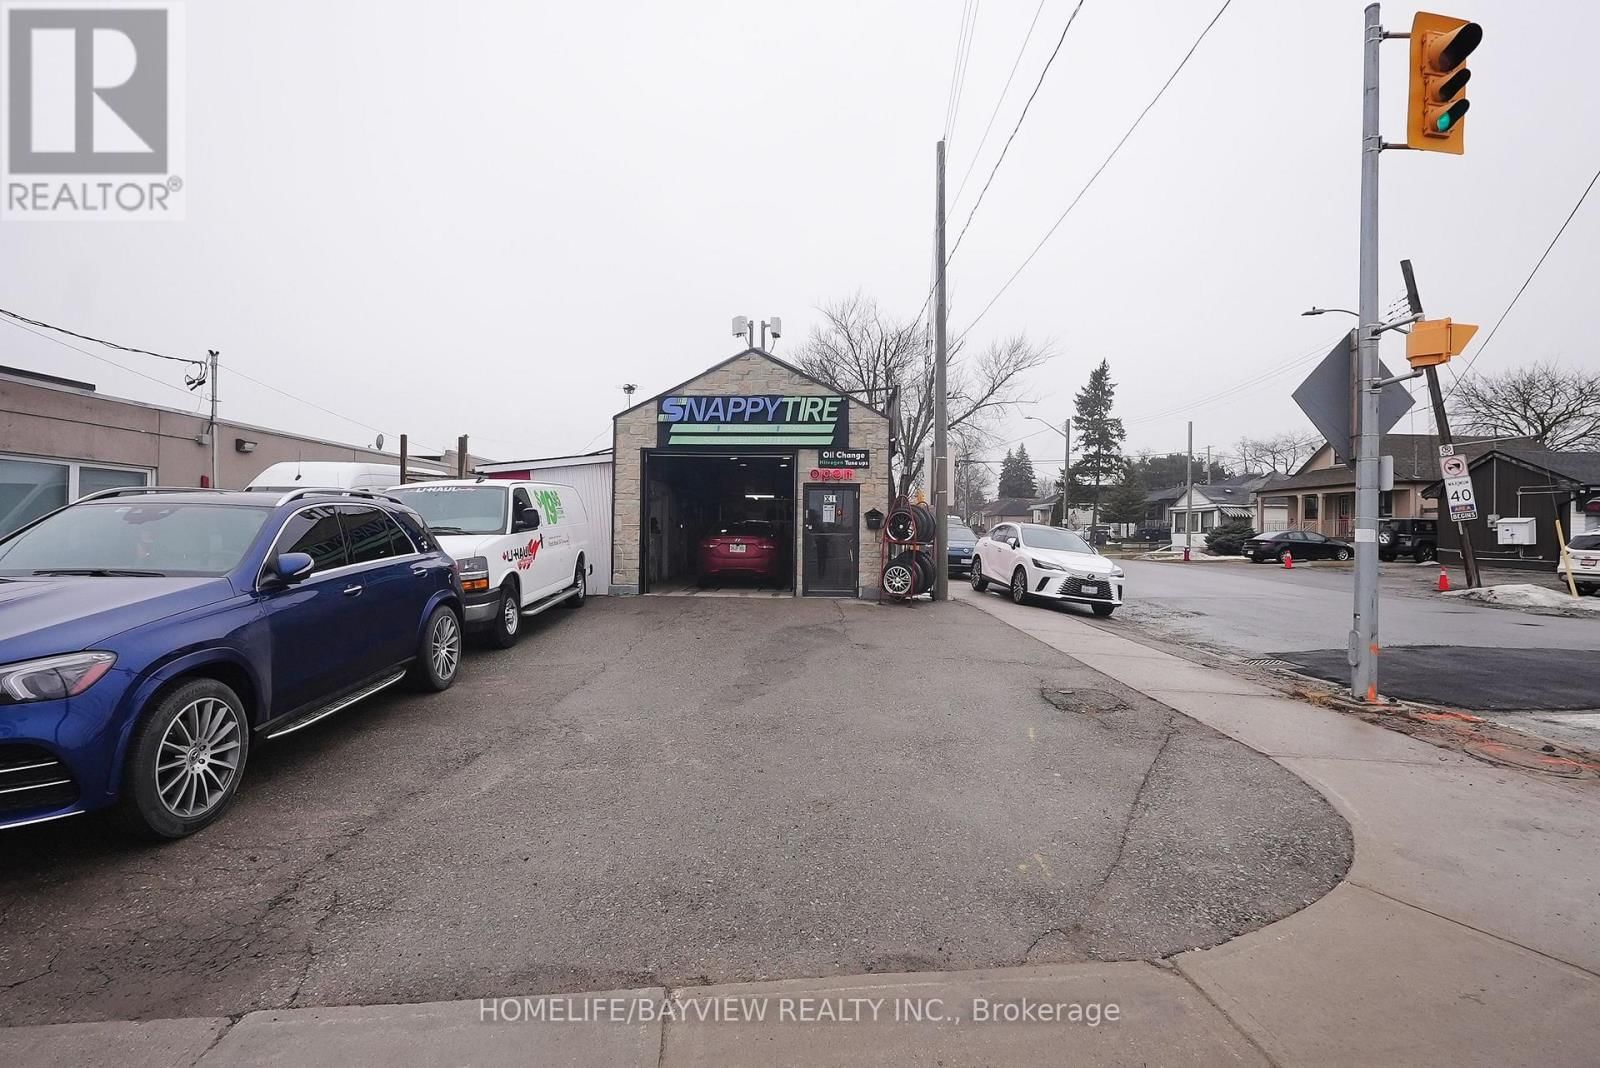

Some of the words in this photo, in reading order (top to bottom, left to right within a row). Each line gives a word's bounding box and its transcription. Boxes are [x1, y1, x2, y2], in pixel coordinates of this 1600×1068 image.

[822, 451, 835, 459] Oil
[836, 451, 866, 460] Change
[1451, 489, 1471, 501] 40
